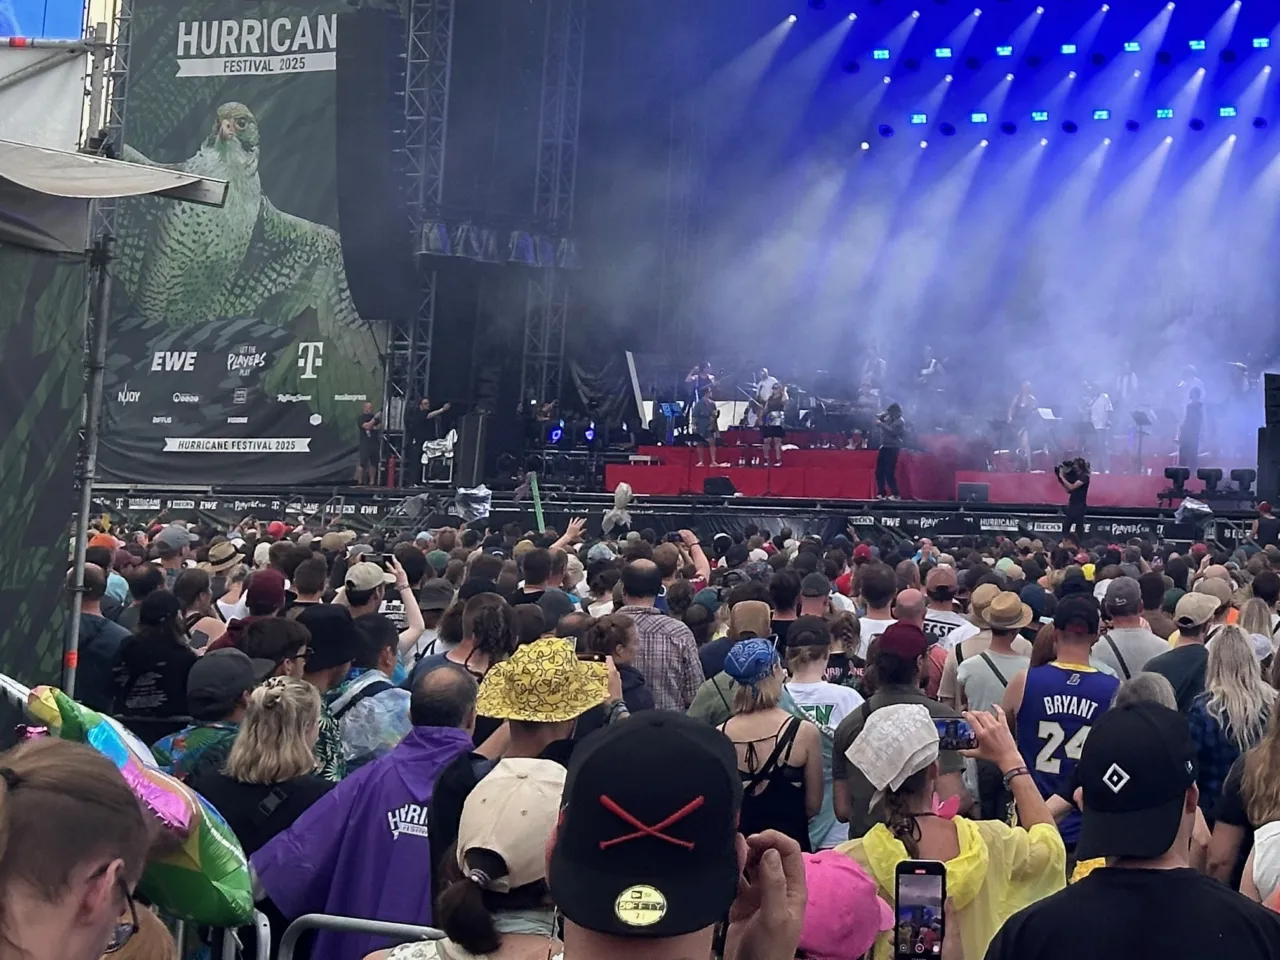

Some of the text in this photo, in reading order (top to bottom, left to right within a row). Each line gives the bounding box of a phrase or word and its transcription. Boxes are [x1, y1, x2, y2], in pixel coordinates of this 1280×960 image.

[177, 13, 337, 55] HURRICAN
[223, 57, 306, 73] FESTIVAL 2025
[151, 351, 197, 371] EWE
[227, 352, 267, 371] PLAYERS
[178, 440, 296, 450] HURRICANE FESTIVAL 2025
[1043, 695, 1099, 719] BRYANT
[1035, 720, 1092, 774] 24
